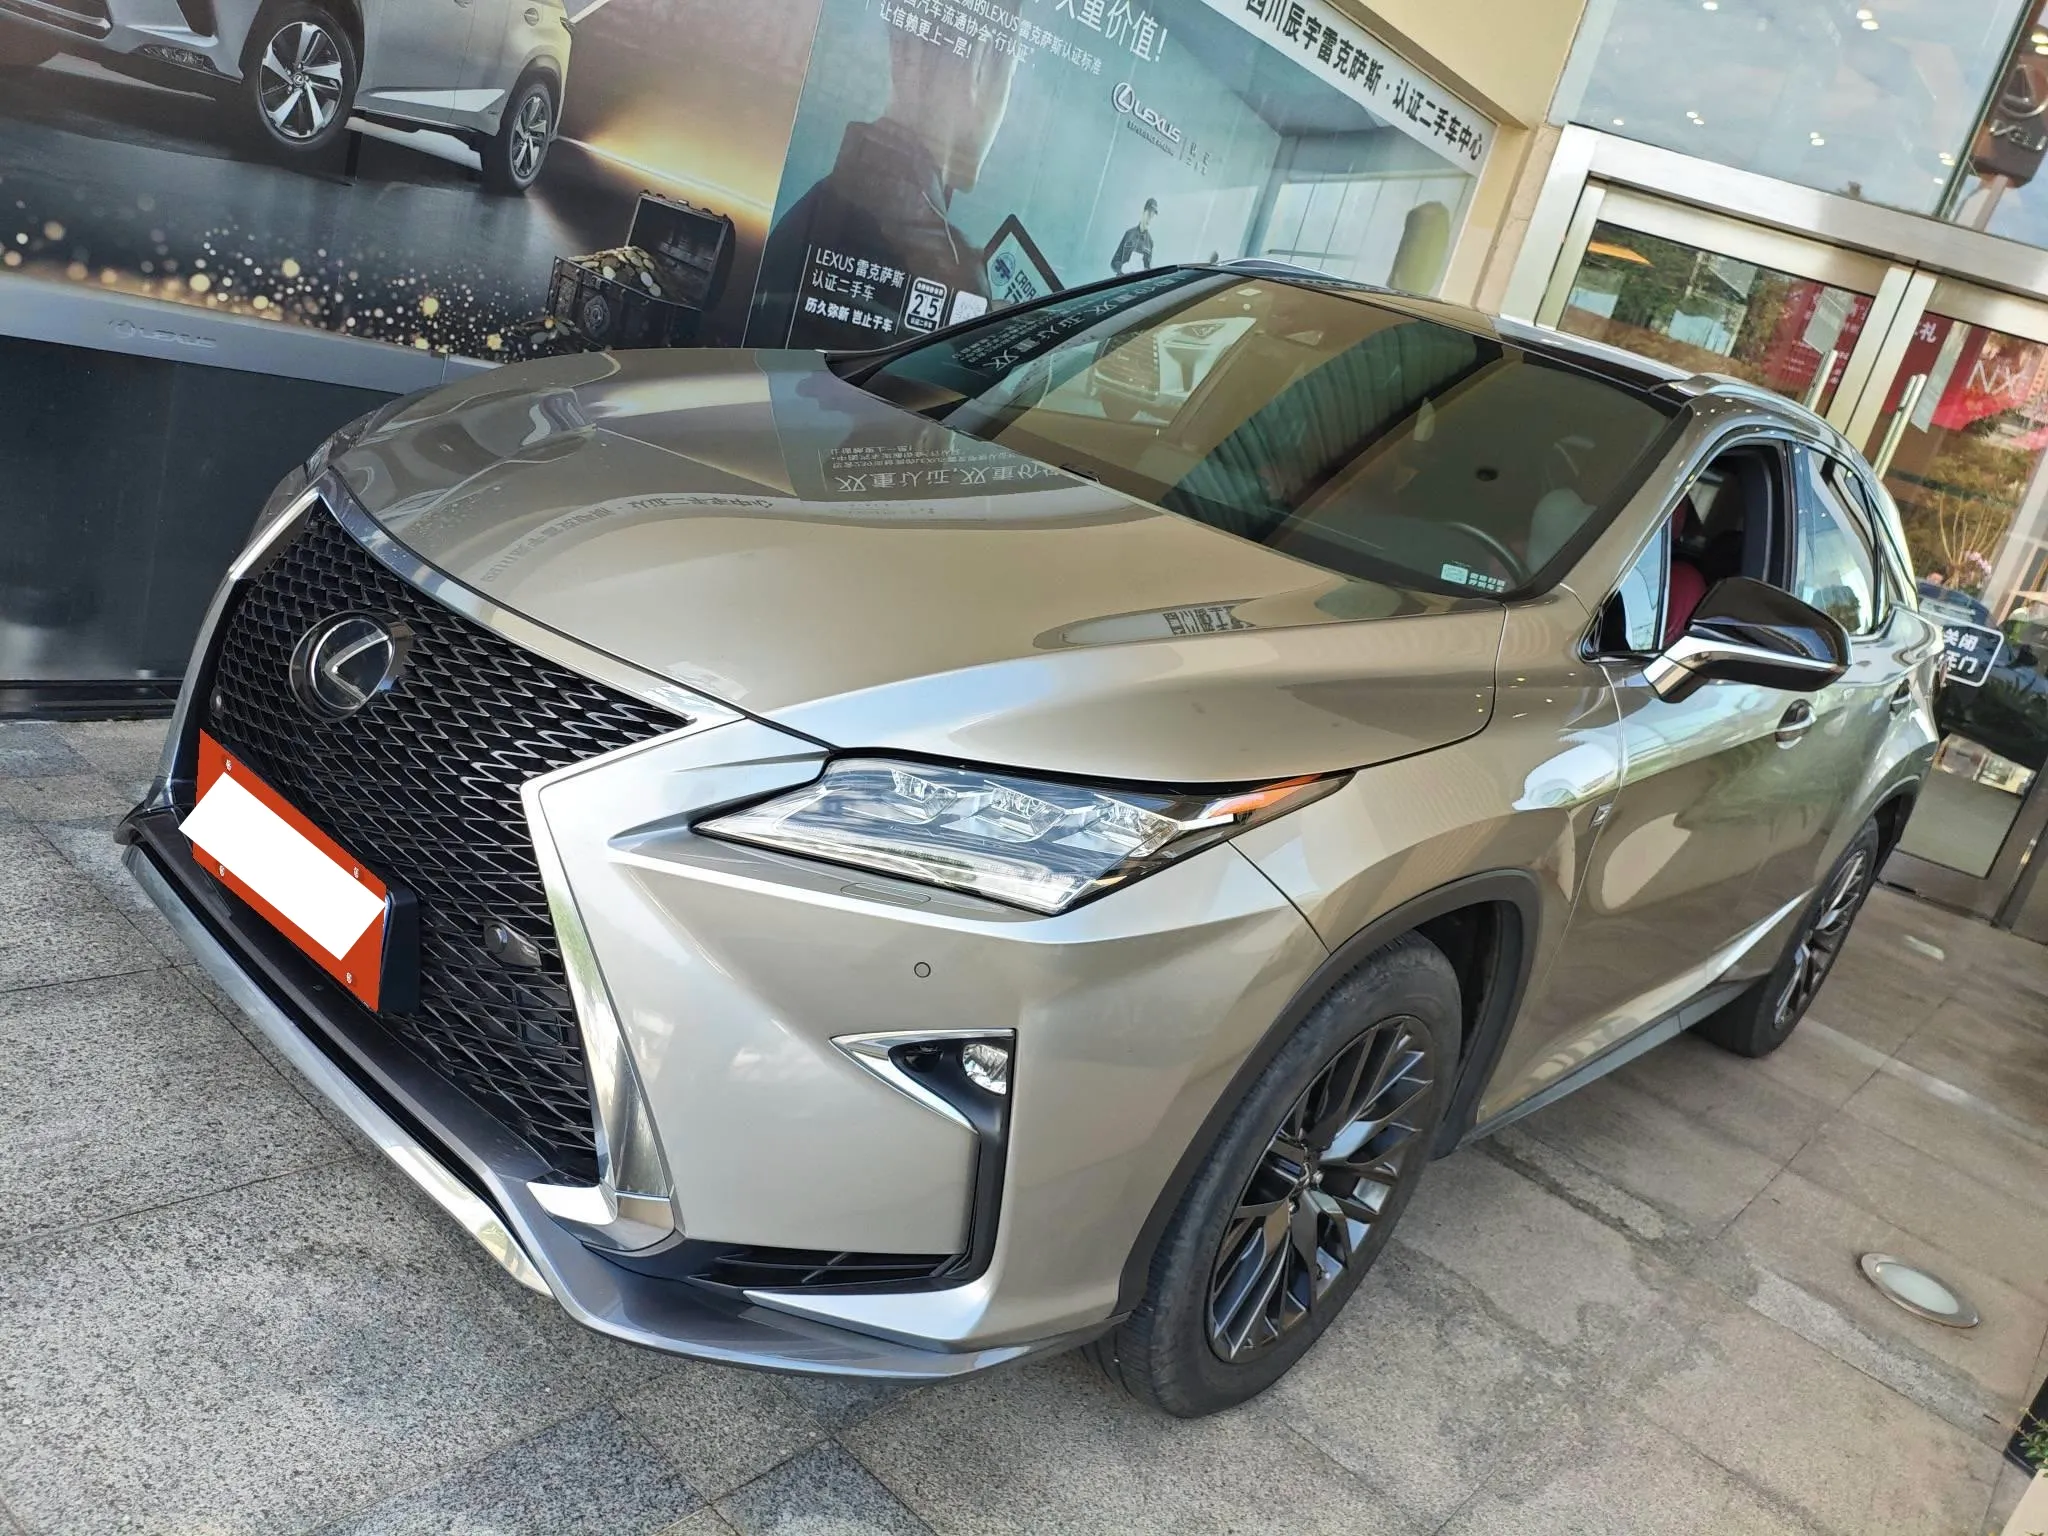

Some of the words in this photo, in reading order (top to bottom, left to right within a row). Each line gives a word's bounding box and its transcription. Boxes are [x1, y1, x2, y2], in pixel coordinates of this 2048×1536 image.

[1133, 100, 1181, 143] LEXUS
[811, 269, 876, 302] 认证二手车
[815, 248, 856, 273] LEXUS
[856, 258, 905, 290] 雷克萨斯
[804, 296, 850, 323] 历久弥新
[851, 309, 894, 334] 岂止于车
[911, 293, 939, 320] 25
[1966, 358, 2025, 401] NX
